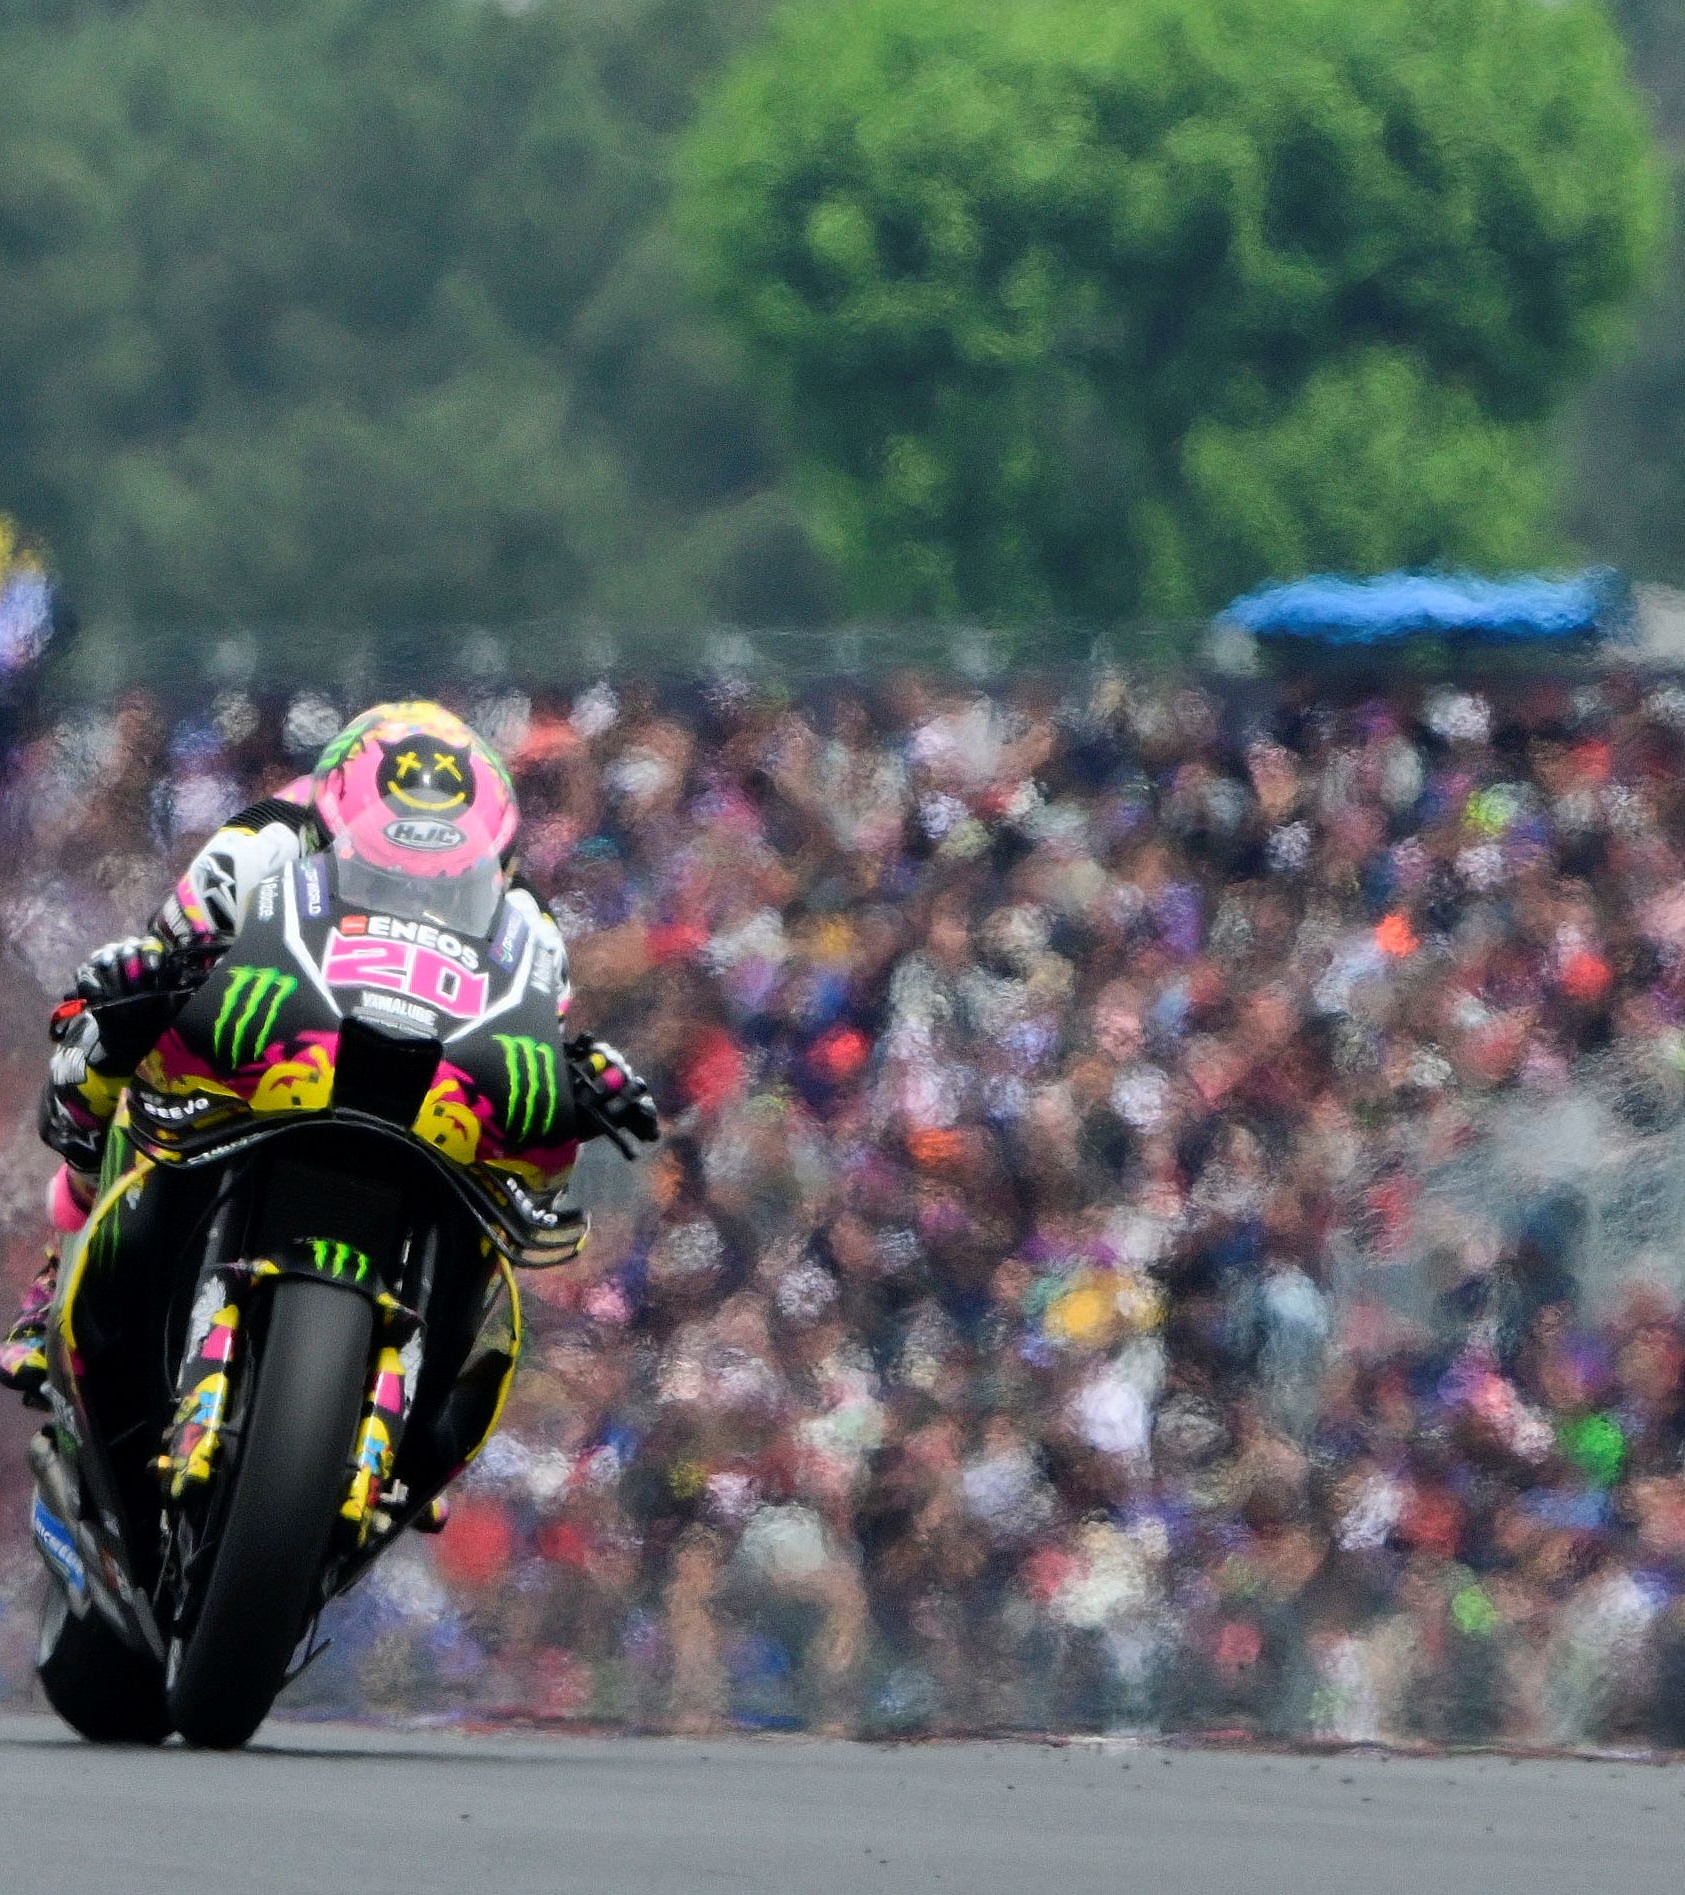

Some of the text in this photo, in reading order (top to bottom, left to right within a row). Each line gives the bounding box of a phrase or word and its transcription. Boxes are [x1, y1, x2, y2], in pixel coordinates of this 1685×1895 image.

[395, 823, 455, 844] HJC
[368, 915, 479, 970] ENEOS
[322, 926, 489, 1019] 20
